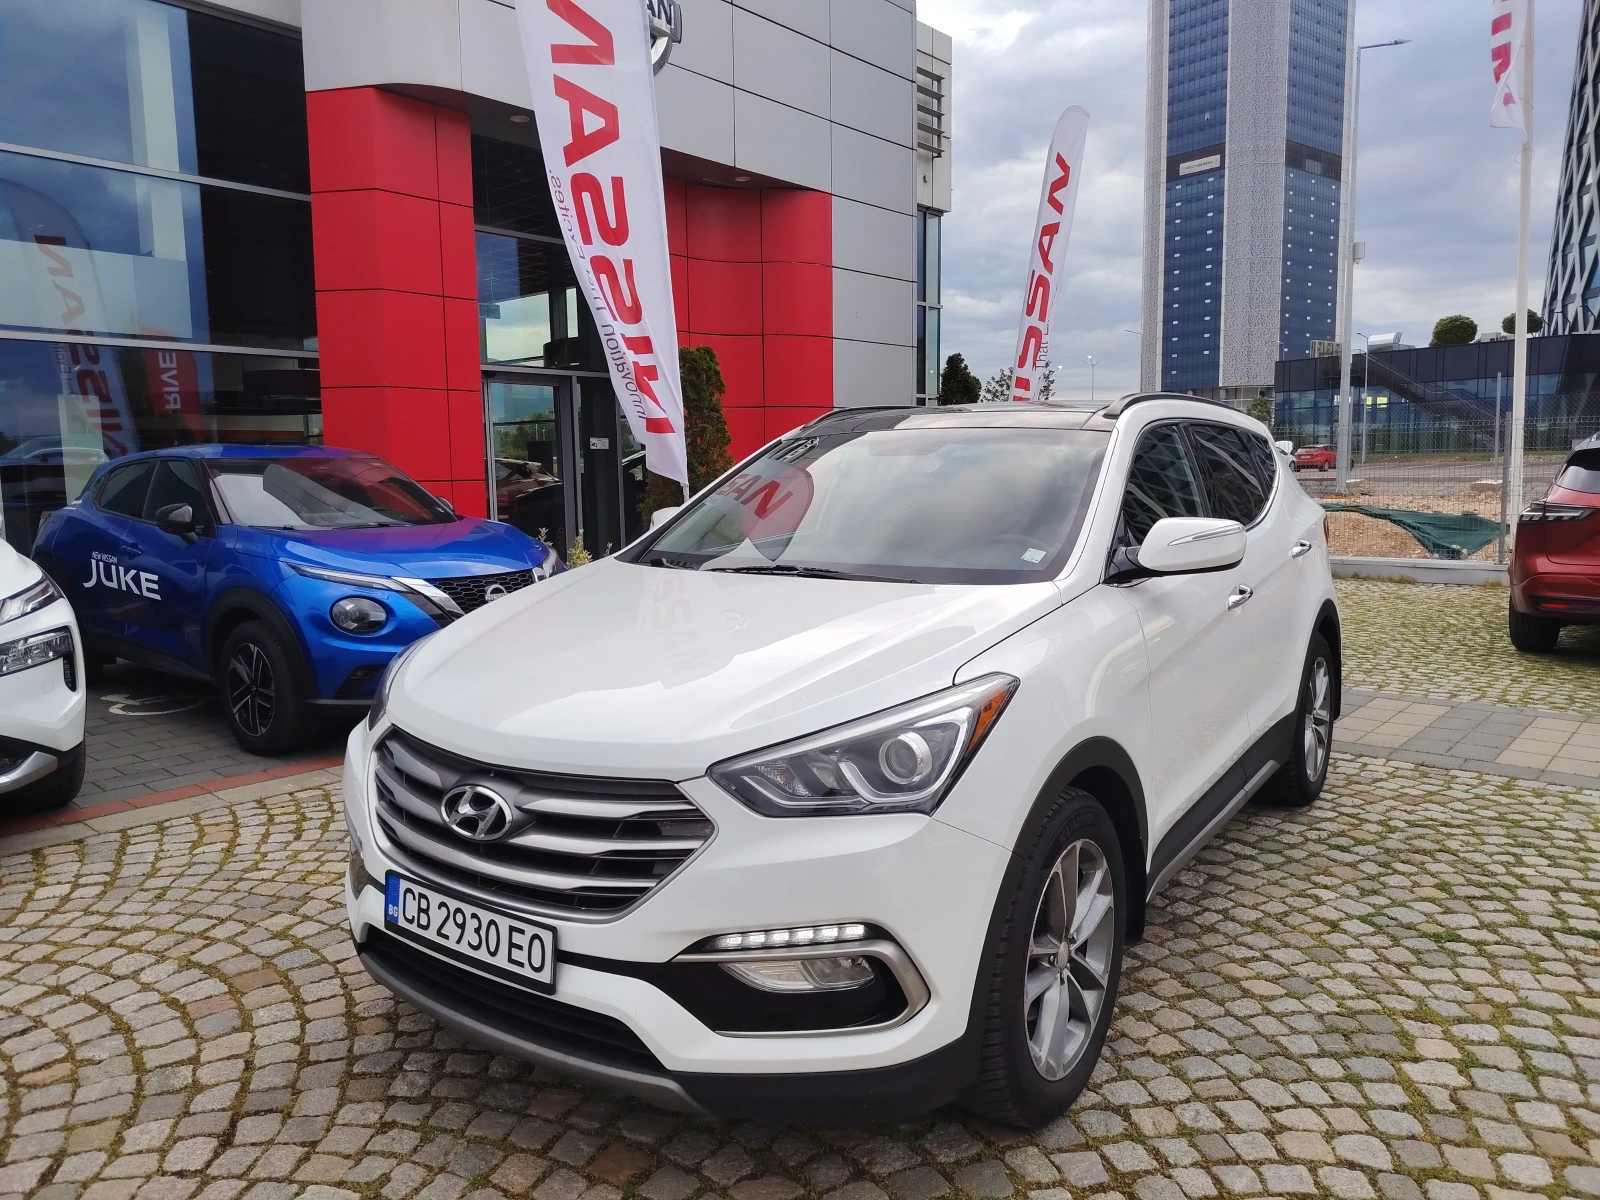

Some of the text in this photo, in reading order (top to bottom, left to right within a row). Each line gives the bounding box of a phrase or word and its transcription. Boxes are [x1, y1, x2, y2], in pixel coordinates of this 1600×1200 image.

[1013, 151, 1071, 401] ISSAN
[82, 558, 162, 601] JUKE
[101, 553, 118, 565] NISSAN
[388, 903, 399, 918] BG
[402, 887, 546, 973] CB 2930 EO
